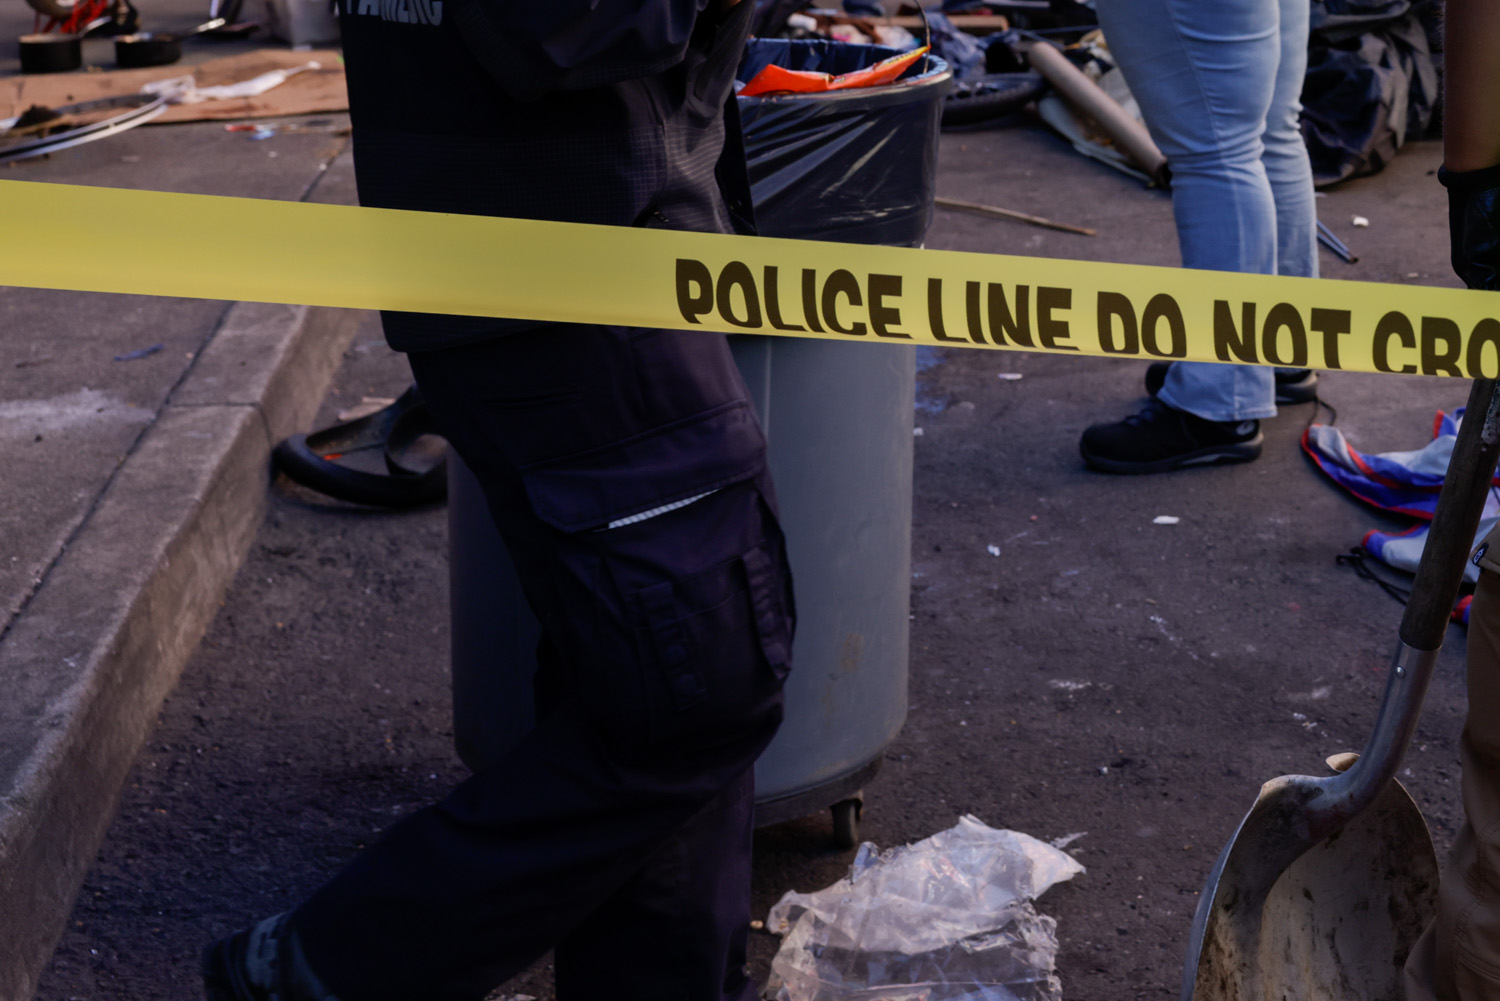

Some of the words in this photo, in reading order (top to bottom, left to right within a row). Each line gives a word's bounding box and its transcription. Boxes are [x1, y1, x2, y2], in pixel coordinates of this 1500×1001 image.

[675, 258, 914, 339] POLICE
[927, 277, 1081, 351] LINE
[1097, 290, 1187, 358] DO
[1213, 299, 1352, 369] NOT
